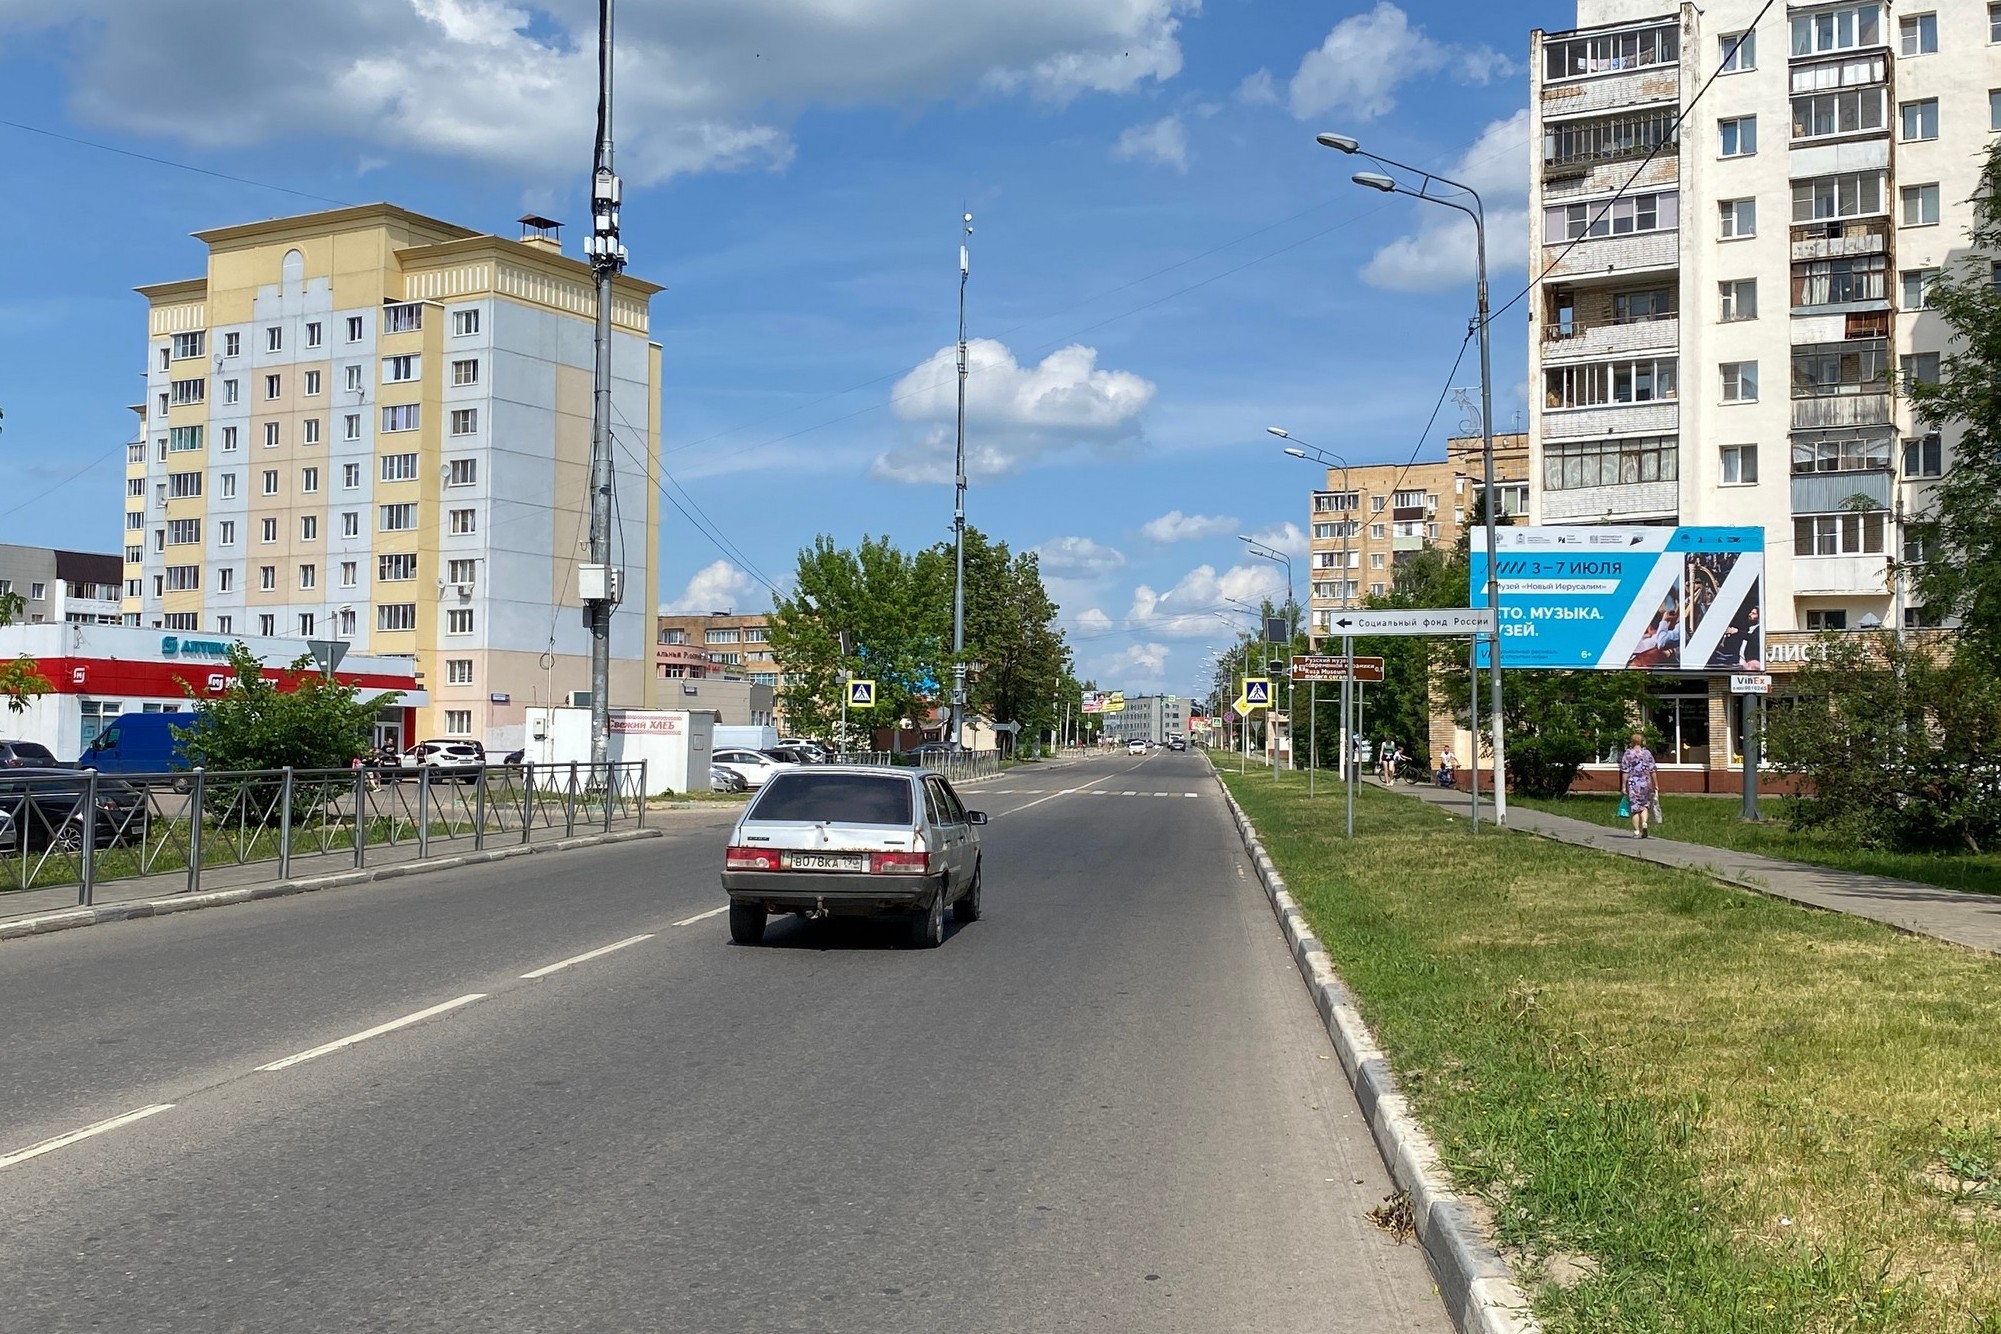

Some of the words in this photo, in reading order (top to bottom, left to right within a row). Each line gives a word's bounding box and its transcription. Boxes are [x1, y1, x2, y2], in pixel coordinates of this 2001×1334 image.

[1570, 562, 1622, 574] ИЮЛЯ
[1555, 582, 1607, 591] Иерусалим»
[1498, 607, 1527, 620] ТО.
[1530, 607, 1604, 620] МУЗЫКА.
[1358, 618, 1417, 628] Социальный
[1423, 618, 1447, 628] фонд
[1454, 617, 1489, 626] России
[181, 640, 231, 654] АПТЕК
[1581, 650, 1592, 659] 6+
[650, 719, 675, 730] ХЛЕБ
